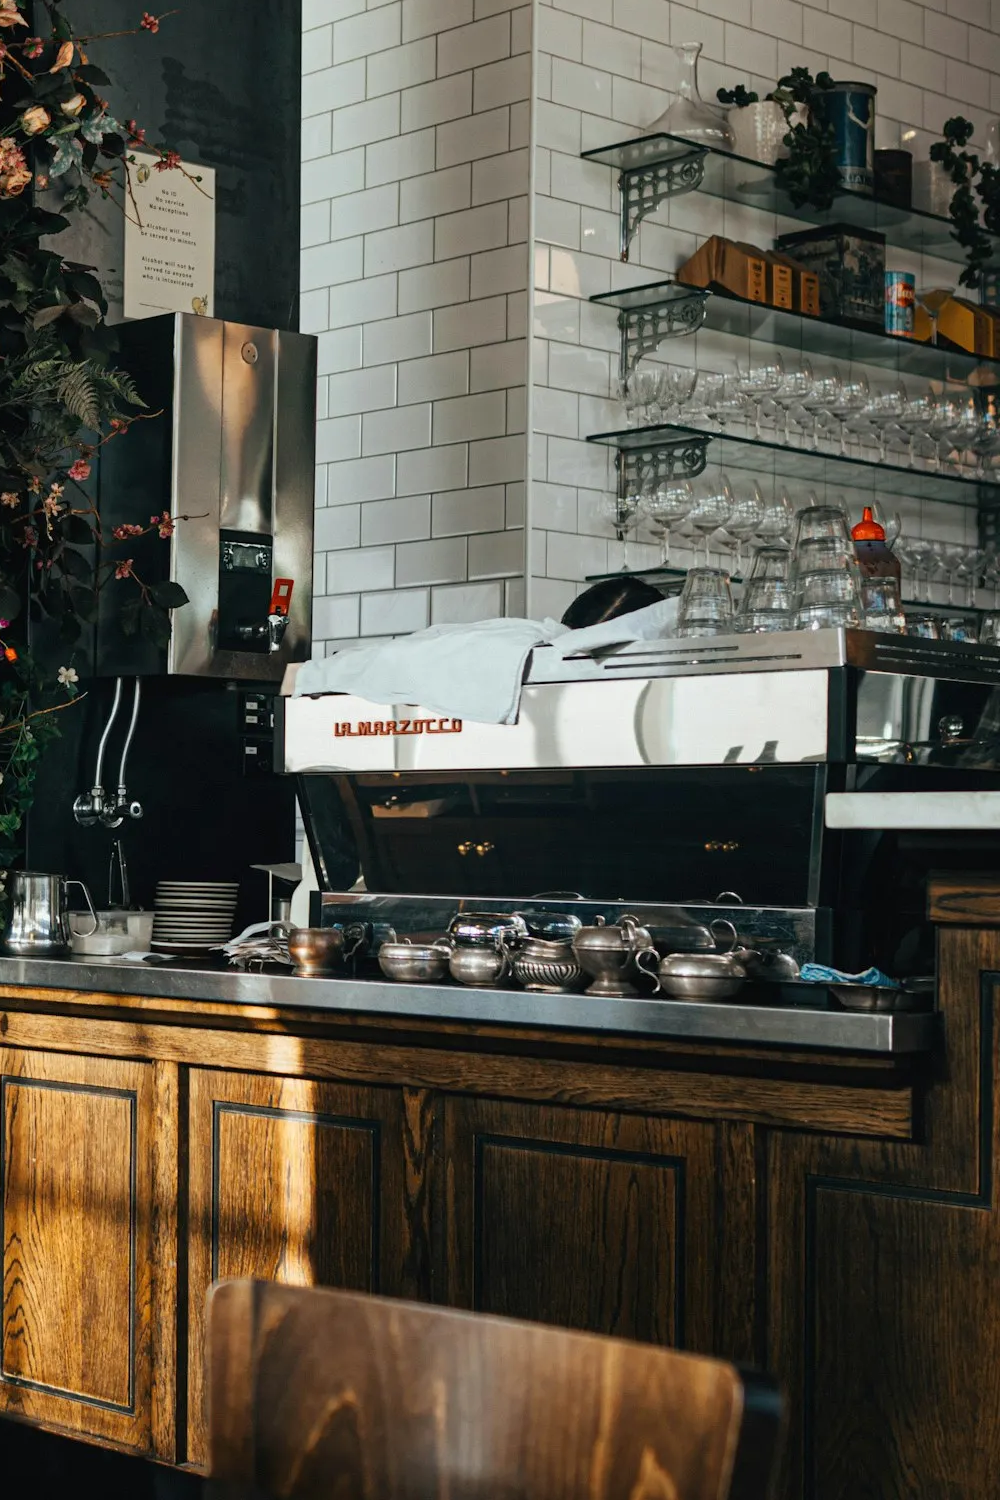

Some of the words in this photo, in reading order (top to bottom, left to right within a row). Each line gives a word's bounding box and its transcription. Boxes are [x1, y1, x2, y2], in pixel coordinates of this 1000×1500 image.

[164, 199, 184, 208] service
[158, 206, 189, 217] exceptions
[146, 223, 168, 232] Alcohol
[149, 232, 168, 241] served
[177, 238, 197, 247] minors
[141, 255, 163, 265] Alcohol
[144, 265, 163, 274] served
[172, 271, 192, 279] anyone
[162, 277, 194, 288] intoxicated
[334, 721, 351, 737] LA
[358, 717, 463, 736] MARZOCCO
